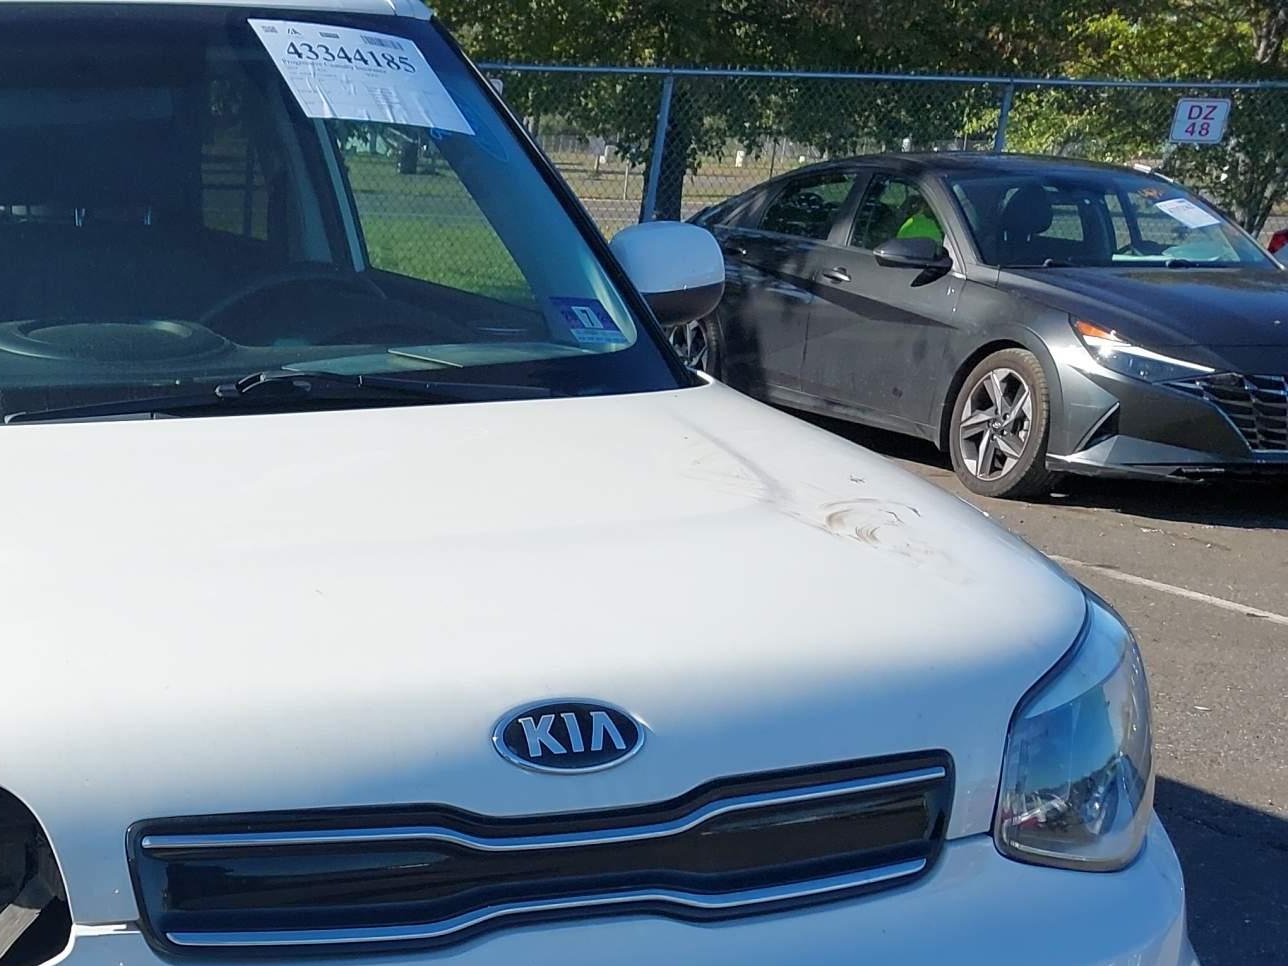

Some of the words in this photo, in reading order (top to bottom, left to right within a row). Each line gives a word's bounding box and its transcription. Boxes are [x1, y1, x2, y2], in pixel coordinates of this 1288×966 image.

[286, 41, 417, 74] 43344185
[1187, 104, 1218, 121] DZ
[1184, 122, 1211, 137] 48
[517, 710, 627, 758] KIA
